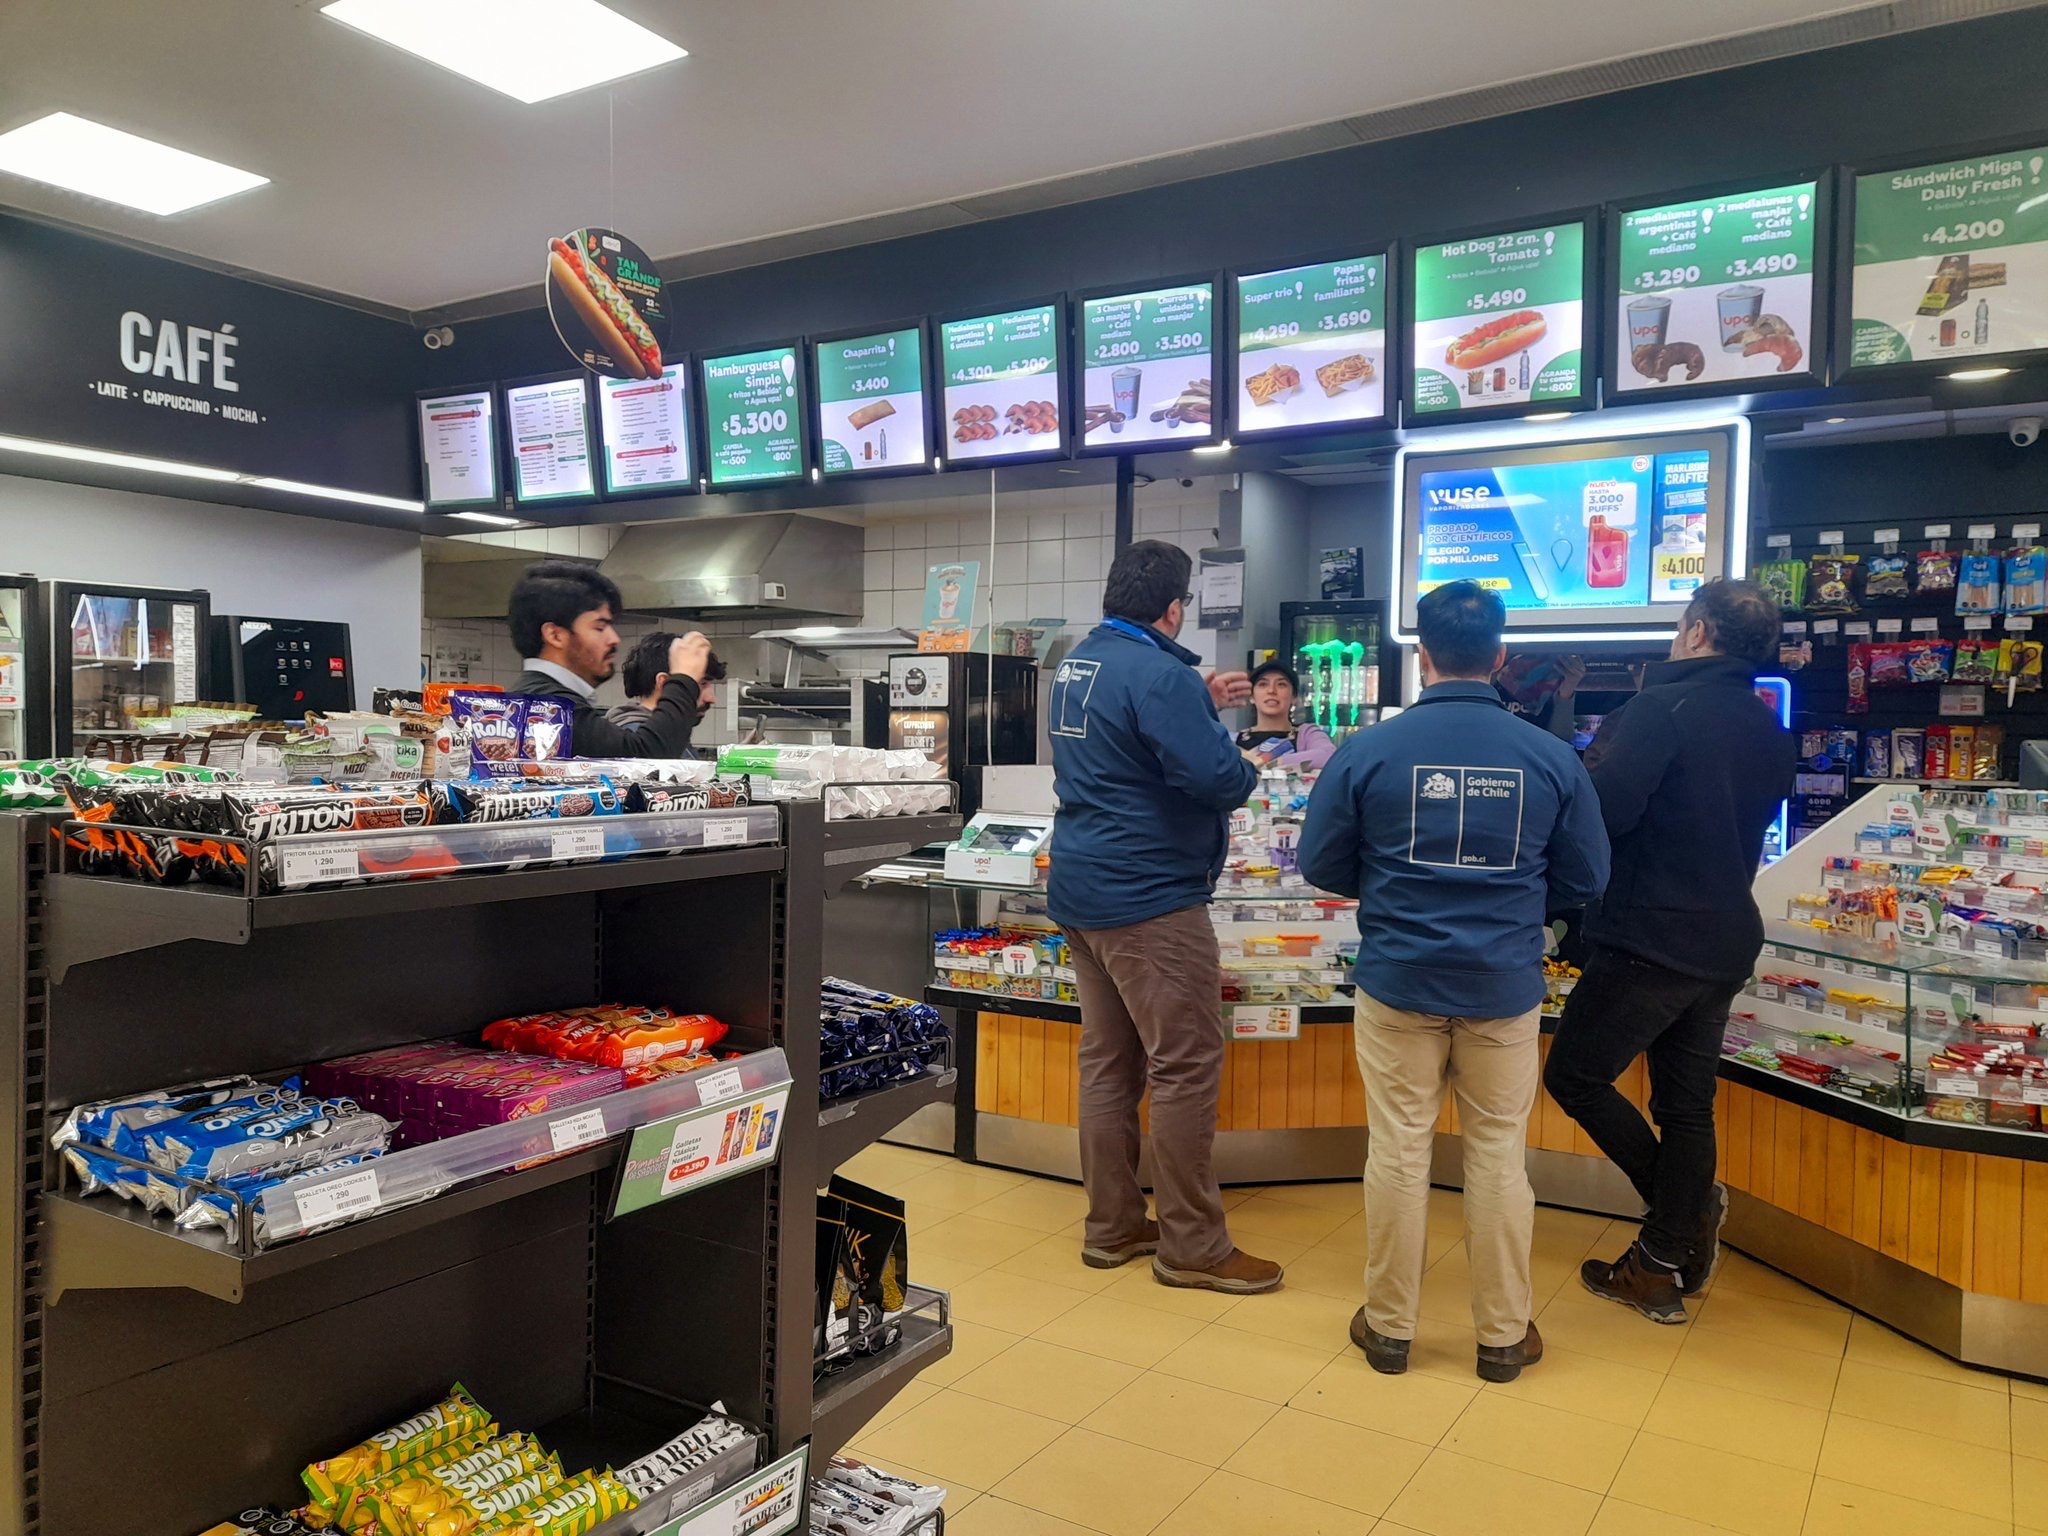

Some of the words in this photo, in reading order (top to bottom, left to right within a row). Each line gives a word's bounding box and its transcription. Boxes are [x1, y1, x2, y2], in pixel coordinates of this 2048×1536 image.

[1891, 166, 1975, 190] Sándwich
[1980, 158, 2024, 177] Miga
[1921, 186, 1967, 202] Daily
[1971, 175, 2023, 194] Fresh
[1718, 203, 1725, 213] 2
[1727, 195, 1794, 211] medialunas
[1627, 217, 1634, 226] 2
[1635, 209, 1697, 225] medialunas
[1752, 206, 1794, 221] manjar
[1638, 221, 1697, 237] argentinas
[1765, 217, 1792, 228] Café
[1671, 229, 1696, 240] Café
[1742, 229, 1792, 244] mediano
[1923, 218, 2005, 244] $4.200
[1442, 245, 1466, 258] Hot
[1468, 241, 1495, 254] Dog
[1498, 235, 1514, 248] 22
[1516, 234, 1540, 245] cm.
[1649, 242, 1696, 255] mediano
[617, 256, 638, 272] TAN
[1489, 248, 1540, 264] Tomate
[1333, 263, 1365, 277] Papas
[1726, 253, 1798, 277] $3.490
[617, 267, 661, 288] GRANDE
[1336, 274, 1365, 287] fritas
[1635, 266, 1701, 288] $3.290
[1158, 295, 1187, 304] Churros
[1245, 292, 1273, 304] Super
[1275, 288, 1293, 298] trio
[1314, 286, 1365, 302] familiares
[1467, 288, 1527, 310] $5.490
[1103, 303, 1131, 312] Churros
[1160, 304, 1194, 313] unidades
[1106, 312, 1131, 322] manjar
[1168, 312, 1194, 322] manjar
[1319, 309, 1372, 330] $3.690
[1250, 322, 1300, 342] $4.290
[1156, 332, 1202, 350] $3.500
[119, 310, 239, 392] CAFÉ
[843, 345, 886, 358] Chaparrita
[1095, 341, 1140, 358] $2.800
[709, 361, 780, 377] Hamburguesa
[745, 374, 781, 388] Simple
[97, 381, 128, 400] LATTE
[143, 389, 210, 416] CAPPUCCINO
[222, 406, 258, 424] MOCHA
[722, 409, 787, 436] $5.300
[1589, 494, 1624, 504] 3.000
[1428, 523, 1477, 533] PROBADO
[1428, 535, 1448, 544] POR
[1450, 532, 1512, 543] CIENTÍFICOS
[1427, 555, 1449, 565] POR
[1450, 553, 1499, 564] MILLONES
[1428, 546, 1470, 556] ELEGIDO
[472, 720, 517, 739] Rolls
[396, 745, 417, 756] tika
[1467, 776, 1516, 788] Gobierno
[1467, 788, 1480, 796] de
[1482, 788, 1510, 798] Chile
[479, 795, 557, 821] TRITON
[248, 803, 351, 842] TRITON
[1462, 855, 1486, 863] gob.cl
[675, 1136, 702, 1148] Galletas
[673, 1144, 699, 1157] Clásicas
[327, 1183, 343, 1191] OREO
[343, 1177, 367, 1187] COOKIES
[329, 1190, 350, 1200] 1.290
[626, 1428, 712, 1483] TUAREG
[743, 1474, 784, 1505] TUAREG
[741, 1499, 782, 1531] TUAREG
